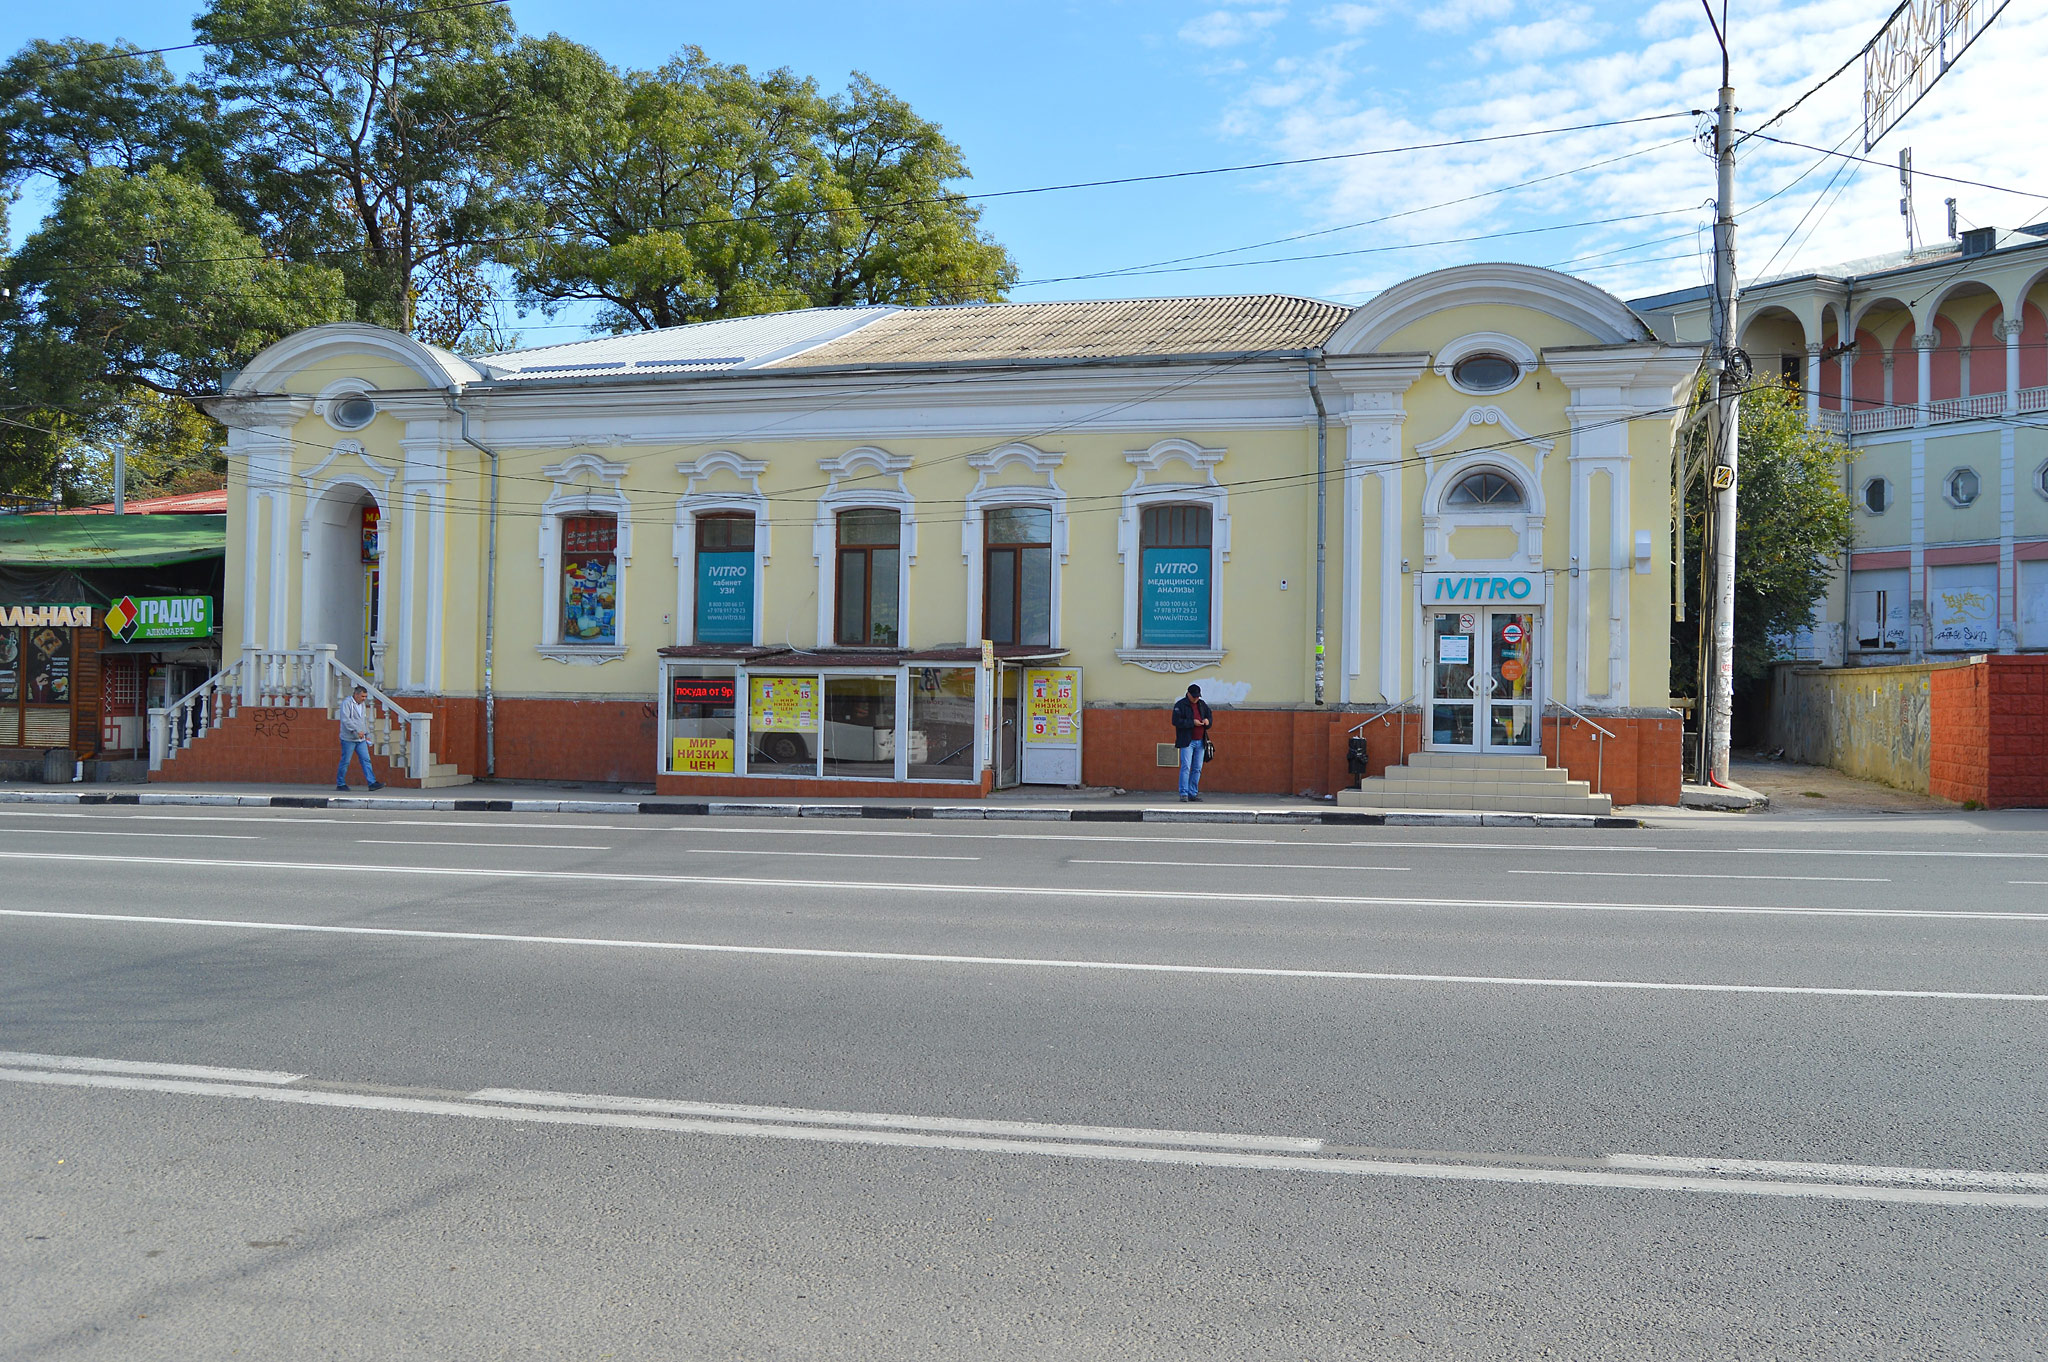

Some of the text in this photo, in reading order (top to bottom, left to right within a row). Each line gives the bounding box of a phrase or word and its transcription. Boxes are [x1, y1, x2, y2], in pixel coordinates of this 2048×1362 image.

[708, 566, 747, 577] iVITRO
[1154, 563, 1199, 574] iVITRO
[1435, 577, 1532, 599] iVITRO
[140, 598, 204, 626] ГРАДУС
[146, 627, 194, 636] АЛКОМАРКЕТ
[676, 687, 707, 697] посуда
[709, 688, 719, 696] от
[690, 739, 716, 748] МИР
[678, 749, 729, 760] НИЗКИХ
[690, 760, 716, 771] ЦЕН
